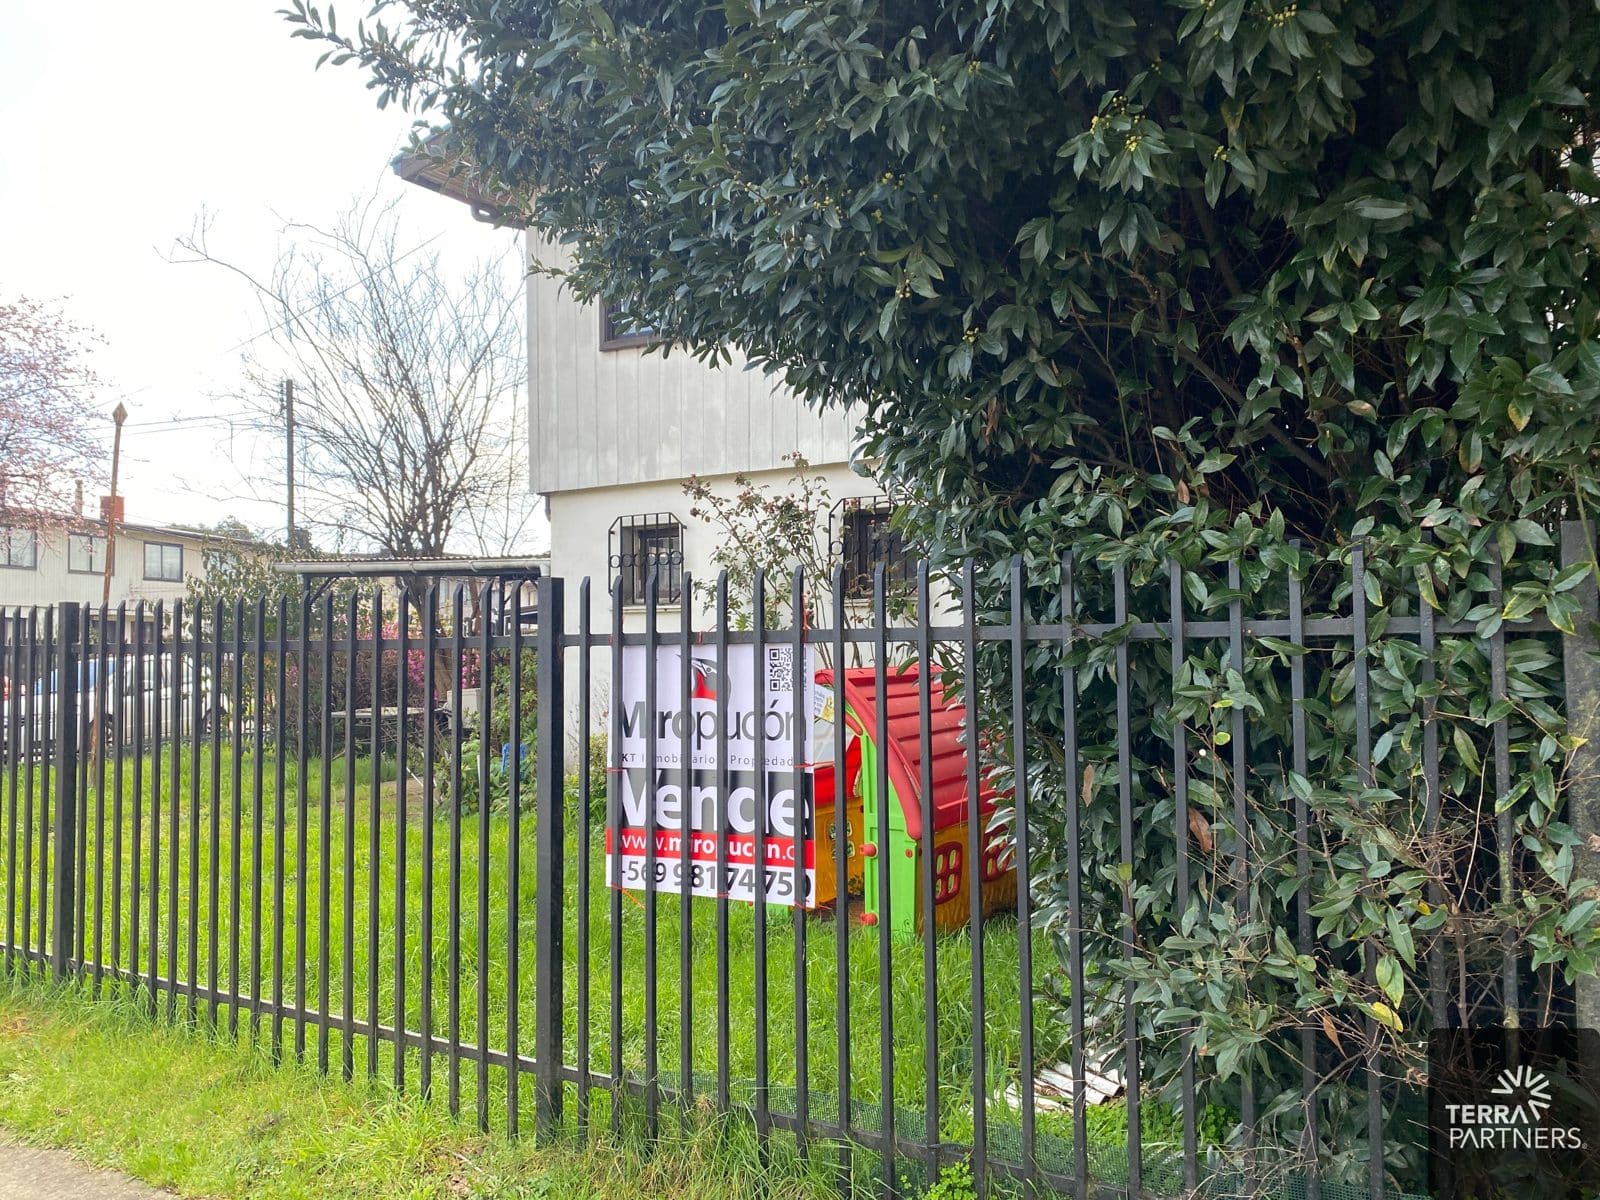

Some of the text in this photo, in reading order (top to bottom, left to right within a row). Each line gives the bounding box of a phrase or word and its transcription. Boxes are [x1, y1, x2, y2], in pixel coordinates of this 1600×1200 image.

[620, 699, 806, 751] Mropucón
[619, 768, 809, 837] Vende
[617, 834, 796, 861] ww.mroucn.c
